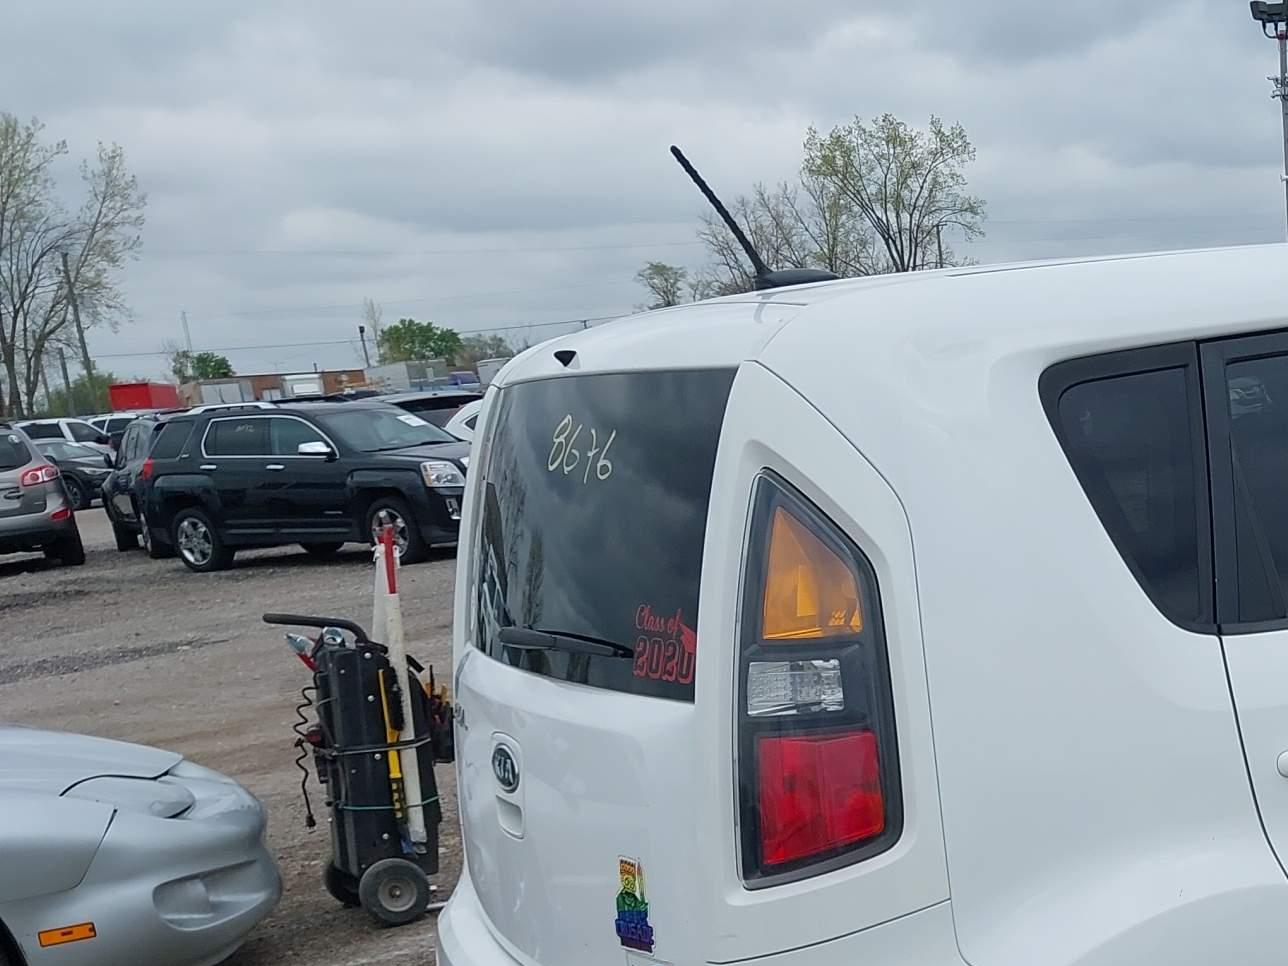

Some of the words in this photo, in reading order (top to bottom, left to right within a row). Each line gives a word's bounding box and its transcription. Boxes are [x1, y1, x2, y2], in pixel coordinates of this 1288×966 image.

[547, 413, 616, 484] 8676
[635, 604, 664, 633] Class
[666, 607, 683, 637] of
[632, 635, 694, 684] 2020
